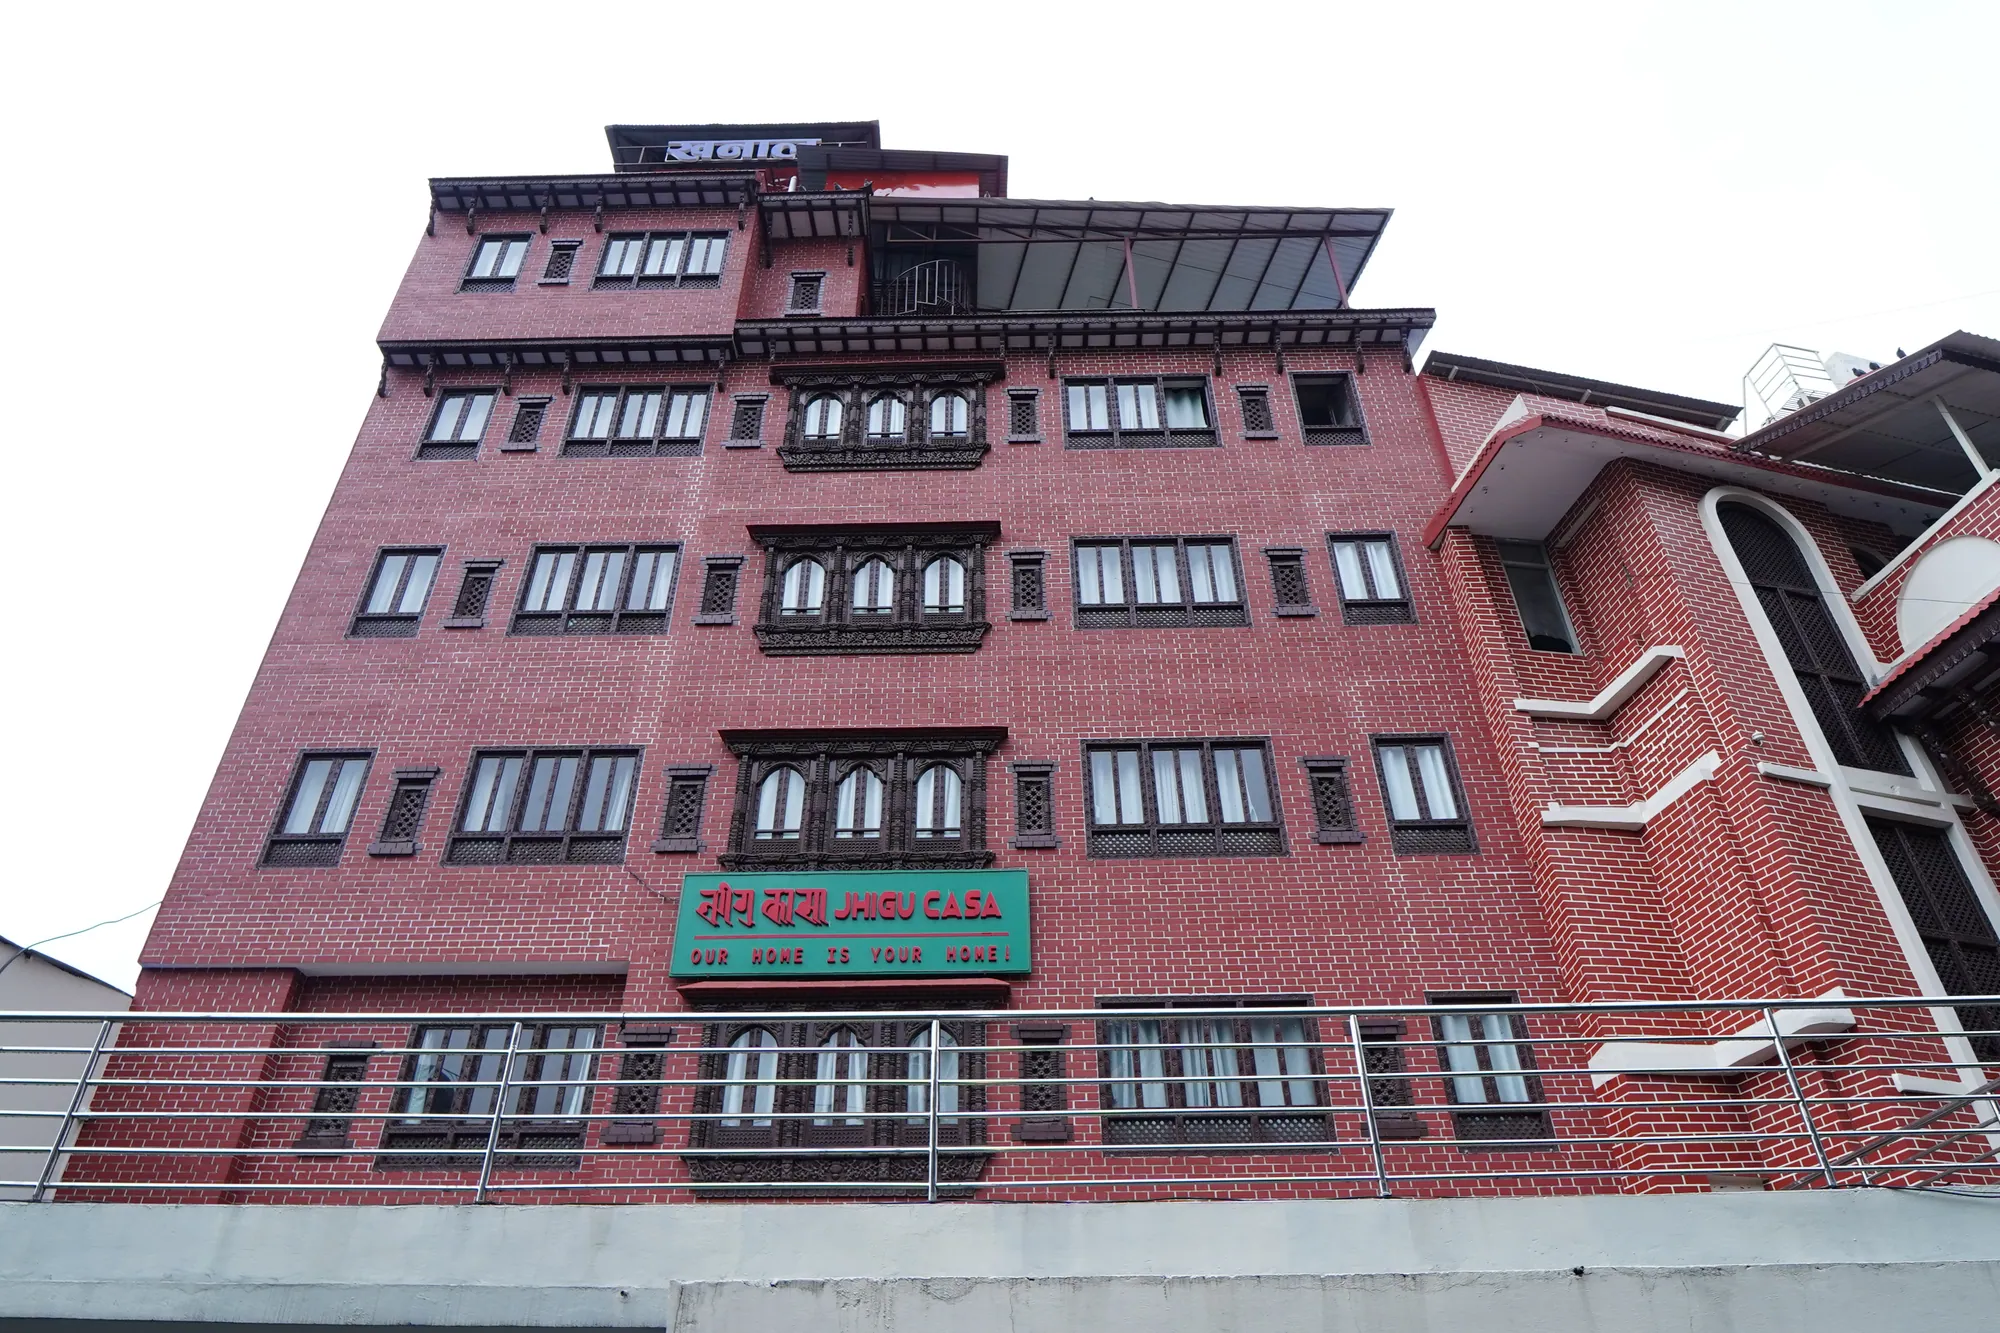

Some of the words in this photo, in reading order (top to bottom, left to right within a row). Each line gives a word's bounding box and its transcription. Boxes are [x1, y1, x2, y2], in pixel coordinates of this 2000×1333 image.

[834, 891, 915, 919] JHIGU
[923, 890, 1001, 918] CASA
[691, 949, 729, 964] OUR
[752, 948, 803, 964] HOME
[827, 947, 850, 963] IS
[871, 946, 921, 963] YOUR
[947, 945, 1010, 961] HOME!
